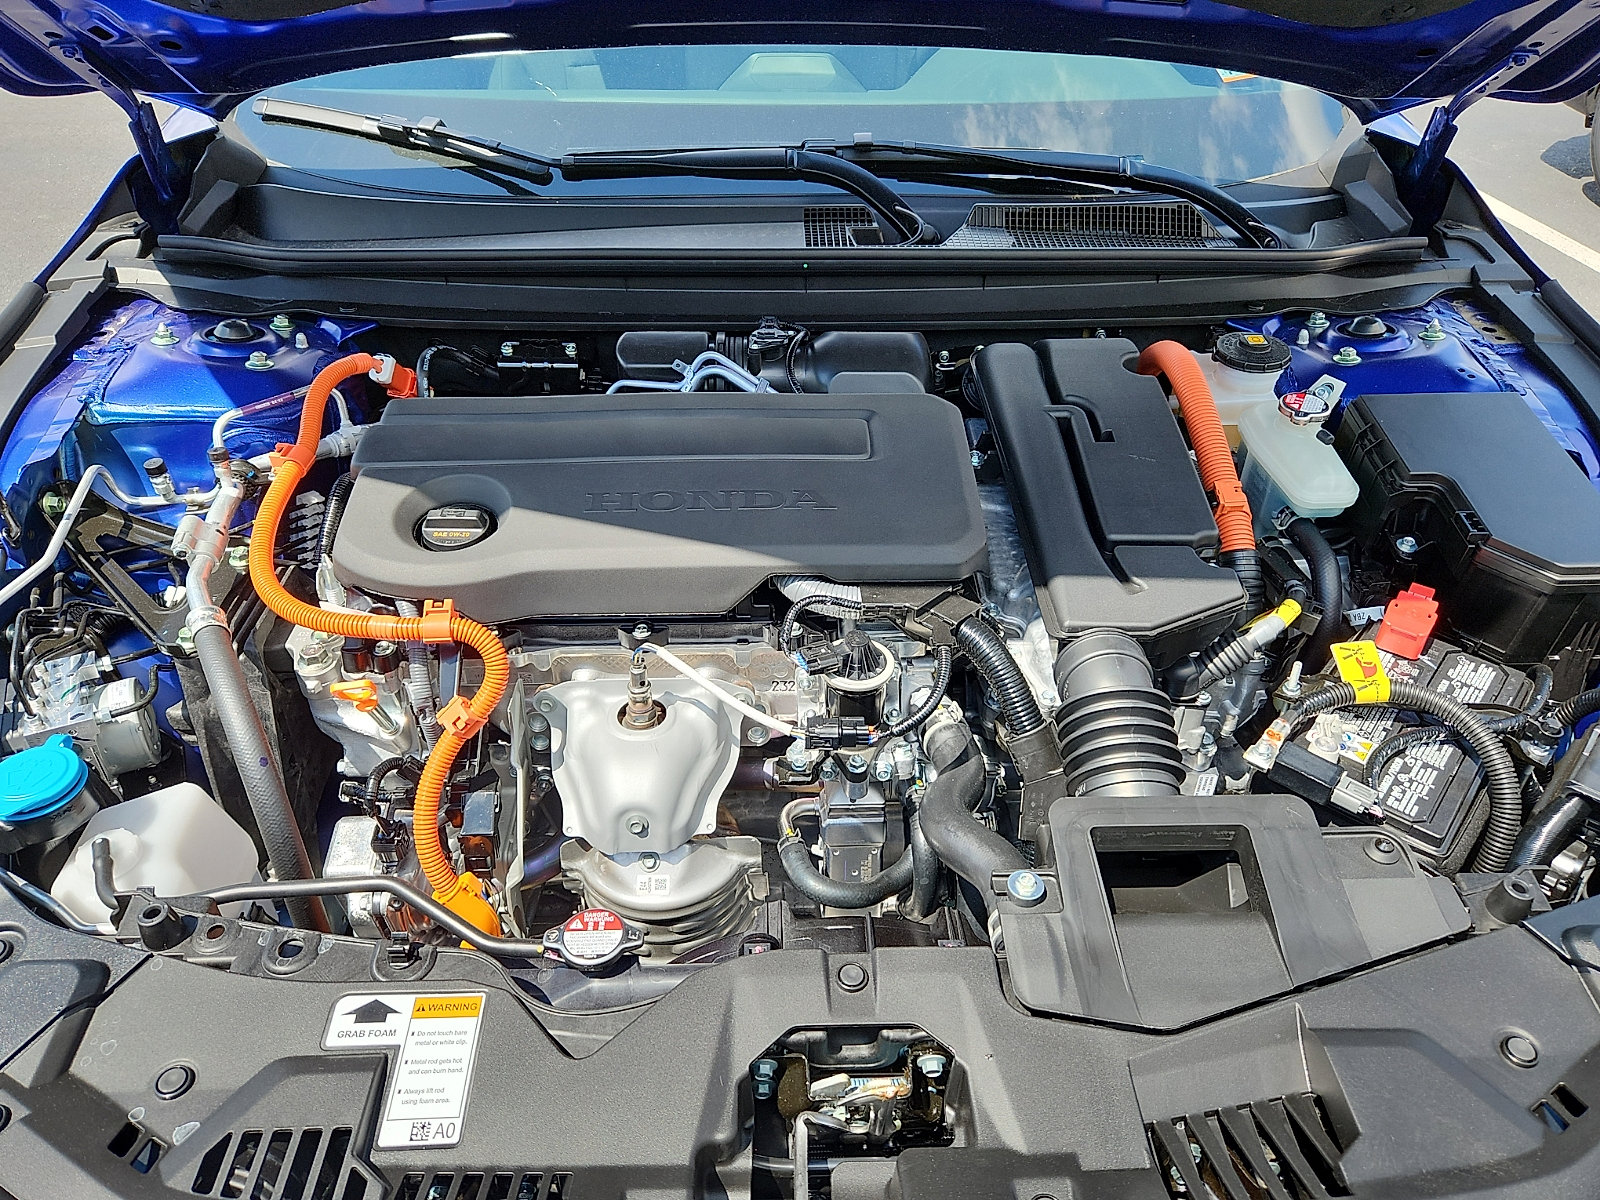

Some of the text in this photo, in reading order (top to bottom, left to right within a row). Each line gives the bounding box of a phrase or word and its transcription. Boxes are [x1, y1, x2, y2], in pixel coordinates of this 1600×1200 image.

[583, 489, 838, 513] HONDA
[771, 680, 796, 692] 232
[427, 1002, 479, 1012] WARNING
[337, 1028, 397, 1039] GRAB FOAM
[437, 1029, 454, 1037] touch
[410, 1058, 427, 1066] Metal
[438, 1058, 452, 1066] gets
[403, 1088, 425, 1096] Always
[432, 1121, 456, 1140] A0
